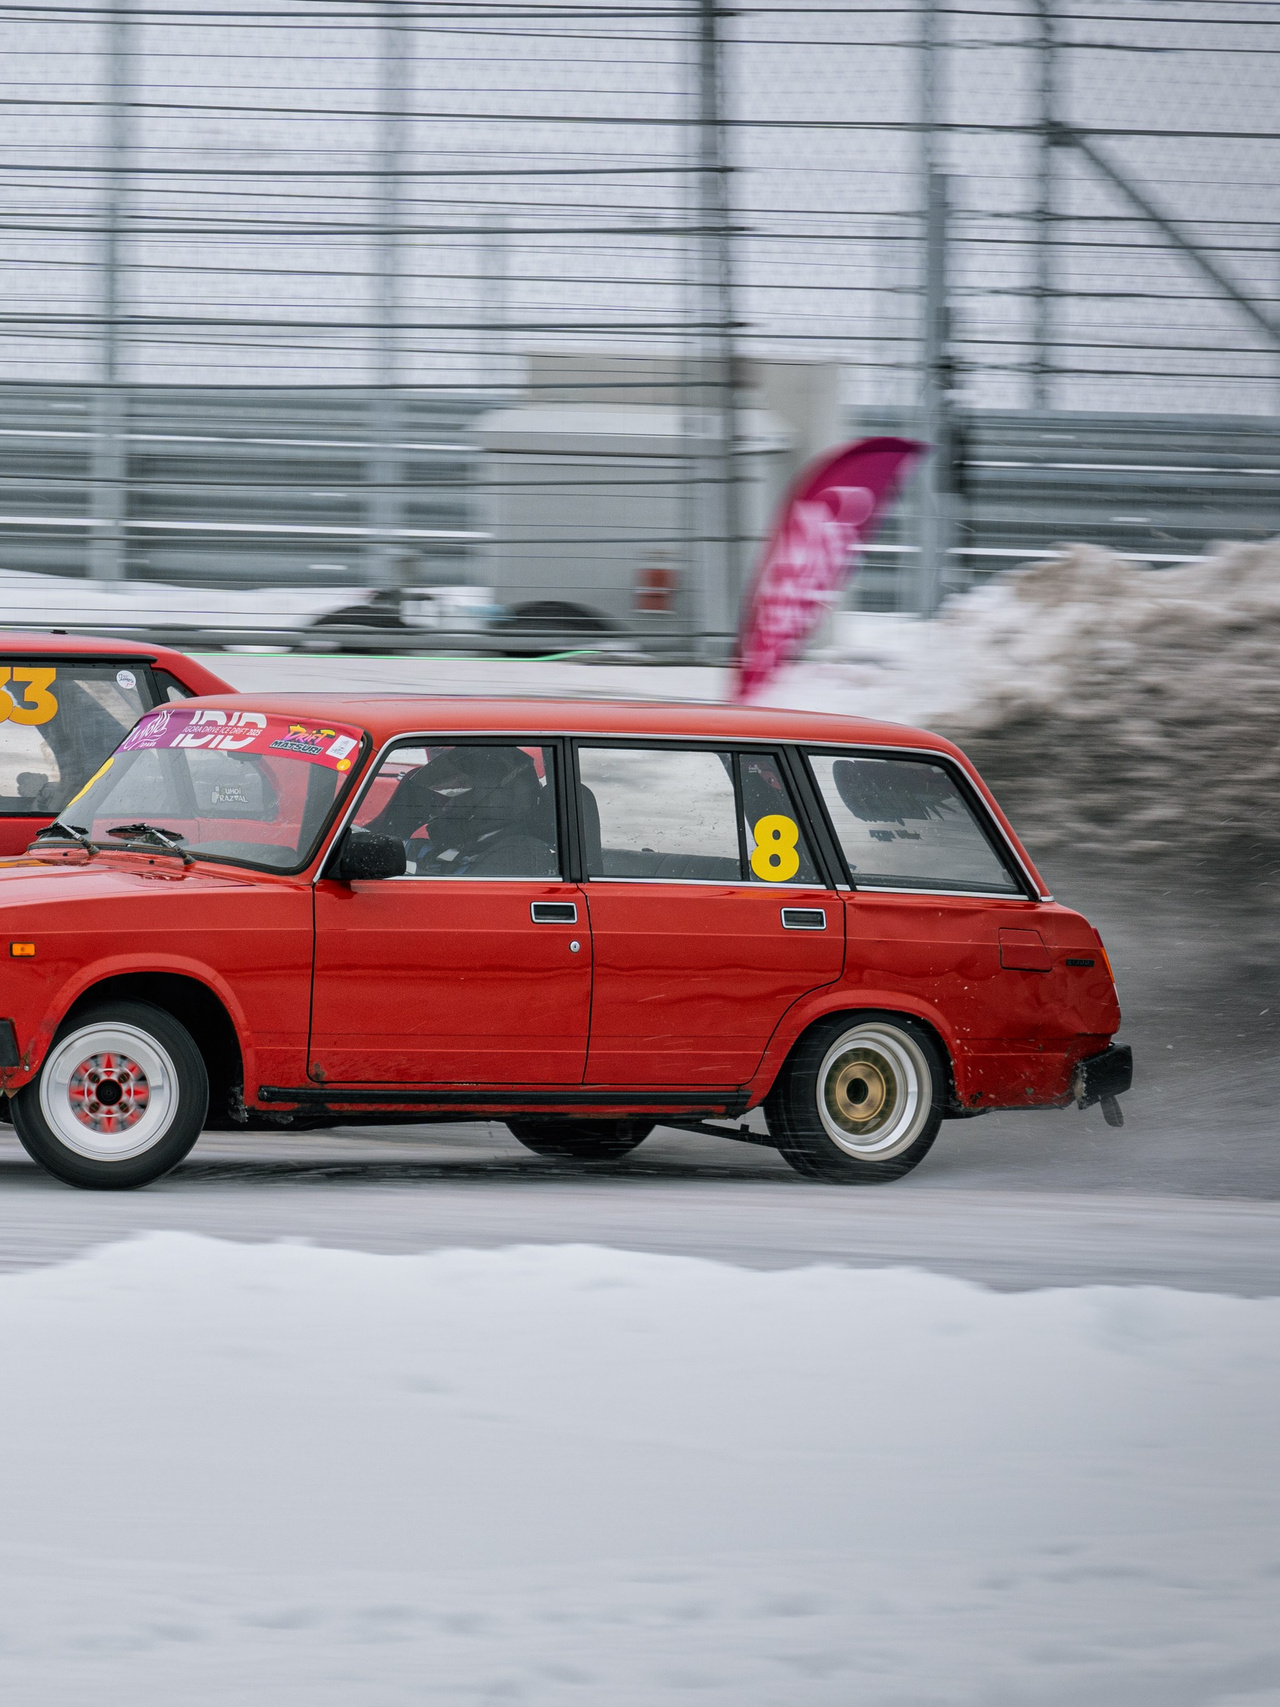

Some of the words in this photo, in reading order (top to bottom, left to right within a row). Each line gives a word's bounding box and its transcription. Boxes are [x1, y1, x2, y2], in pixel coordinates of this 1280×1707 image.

[182, 725, 201, 733] IGORA
[201, 726, 221, 734] DRIVE
[230, 727, 249, 735] DRIFT
[269, 739, 324, 755] MATSURI
[750, 814, 800, 882] 8
